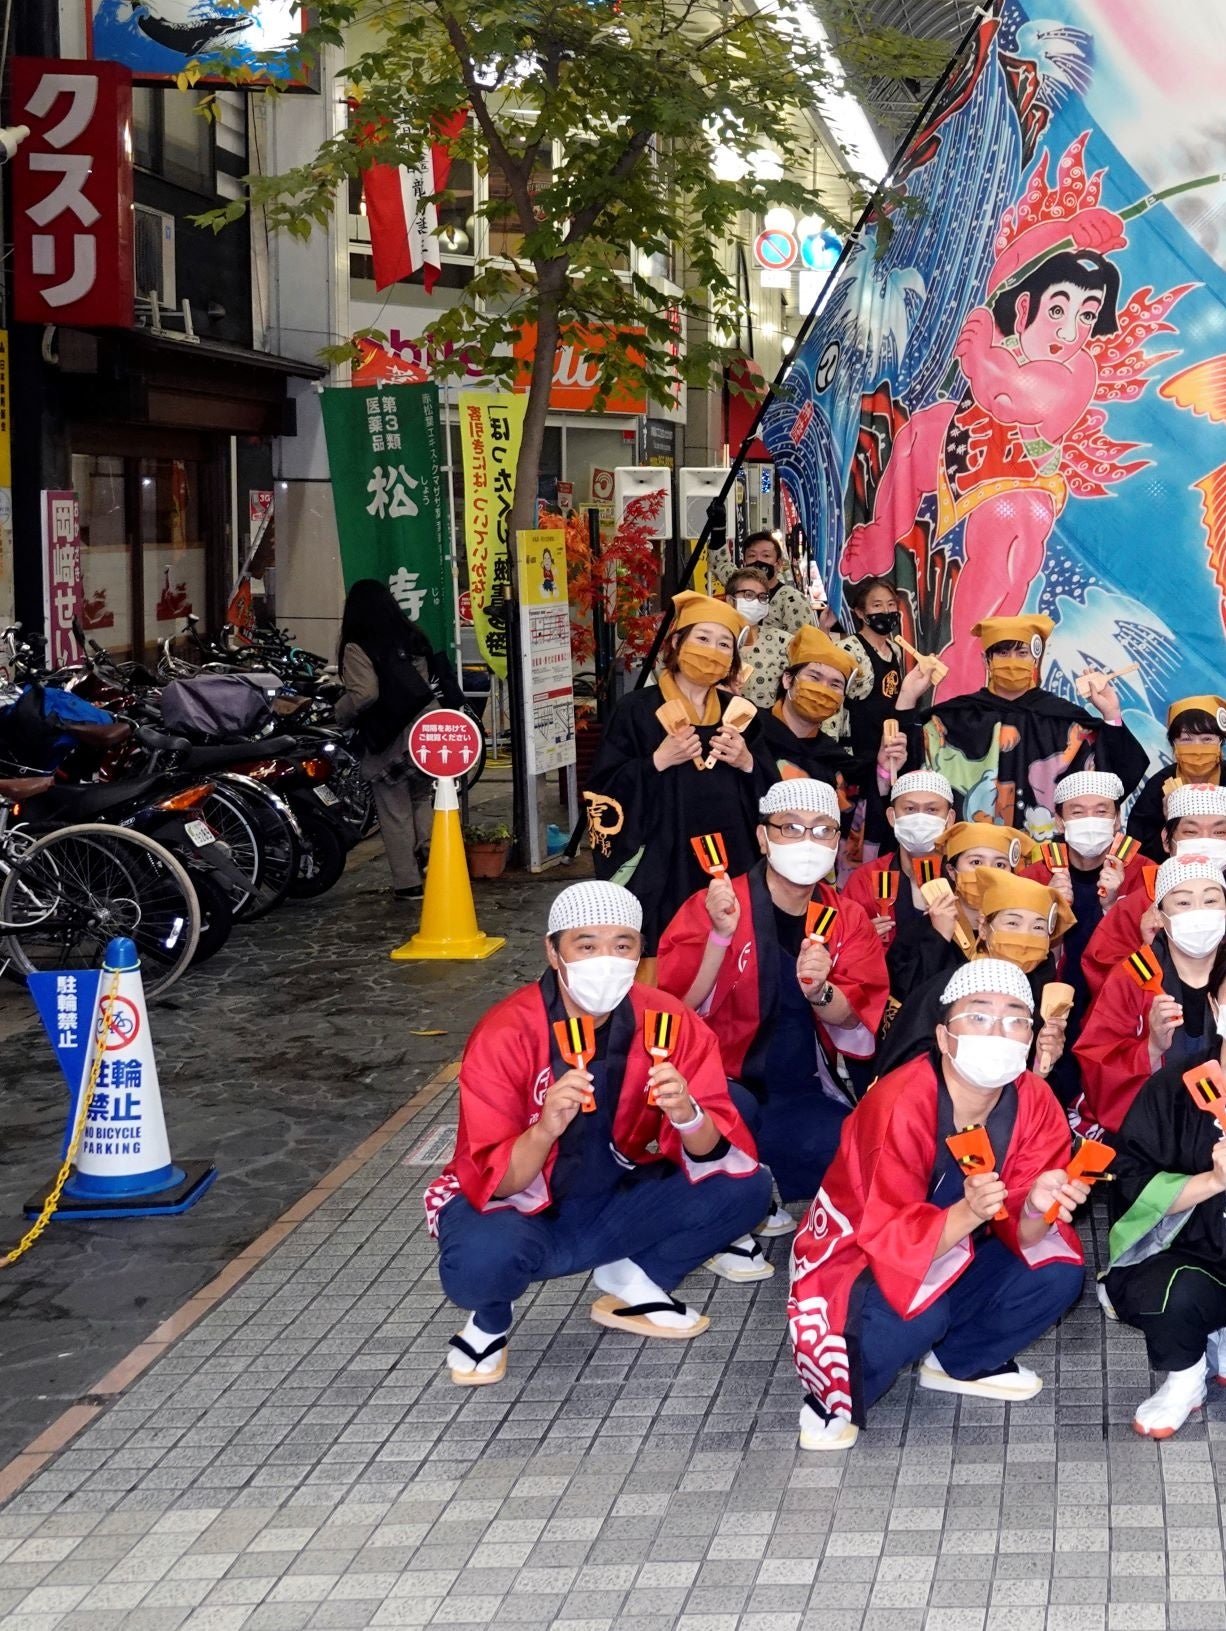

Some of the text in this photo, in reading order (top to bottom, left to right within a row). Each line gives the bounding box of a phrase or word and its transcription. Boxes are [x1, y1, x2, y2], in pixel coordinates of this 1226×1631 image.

[24, 74, 101, 307] クスリ
[421, 724, 468, 733] 間隔をあけて
[418, 733, 472, 742] ご観覧ください
[57, 975, 78, 1049] 駐輪禁止
[96, 1126, 142, 1139] BICYCLE
[83, 1141, 141, 1155] PARKING
